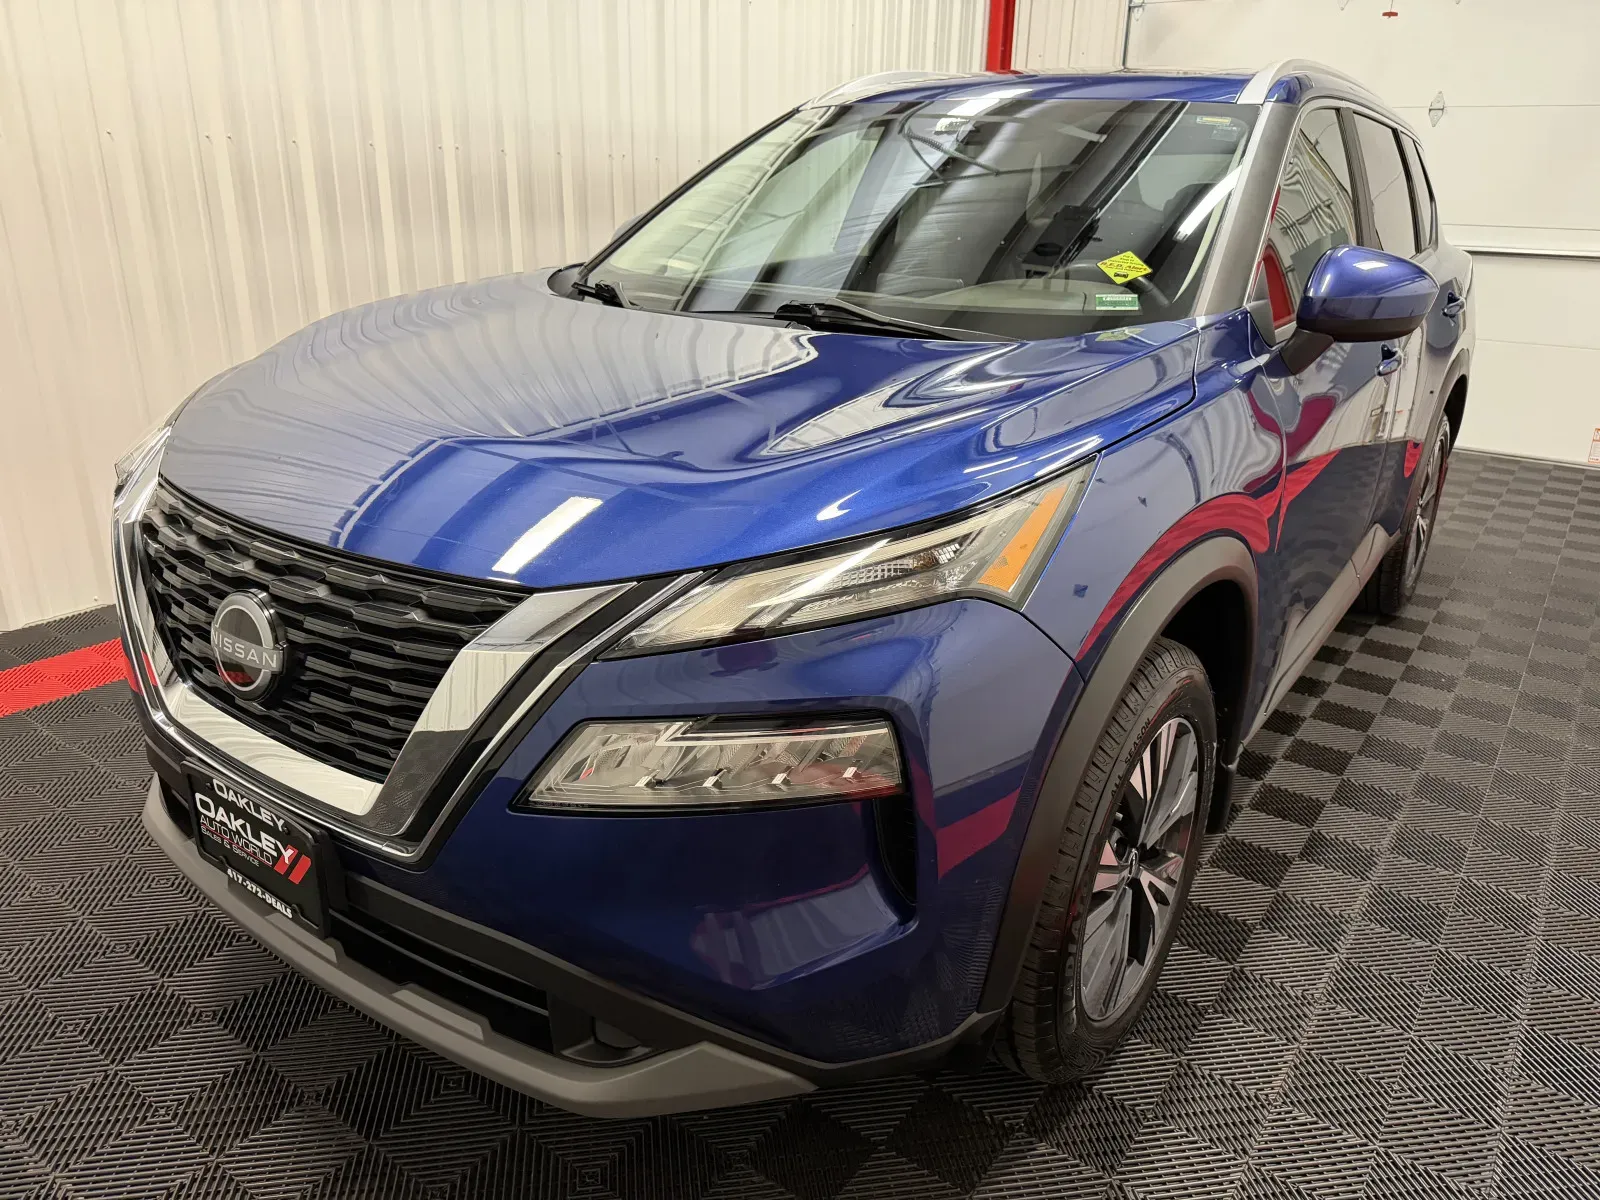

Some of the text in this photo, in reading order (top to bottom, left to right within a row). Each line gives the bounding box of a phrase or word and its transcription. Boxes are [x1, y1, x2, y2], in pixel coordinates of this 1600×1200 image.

[212, 629, 277, 668] NISSAN
[1111, 718, 1151, 798] ALL SEASON
[195, 792, 295, 864] OAKLEY
[213, 778, 285, 832] OAKLEY
[200, 814, 273, 865] AUTO WORLD
[200, 825, 260, 867] SALES & SERVICE
[226, 868, 293, 919] 417-272-DEALS
